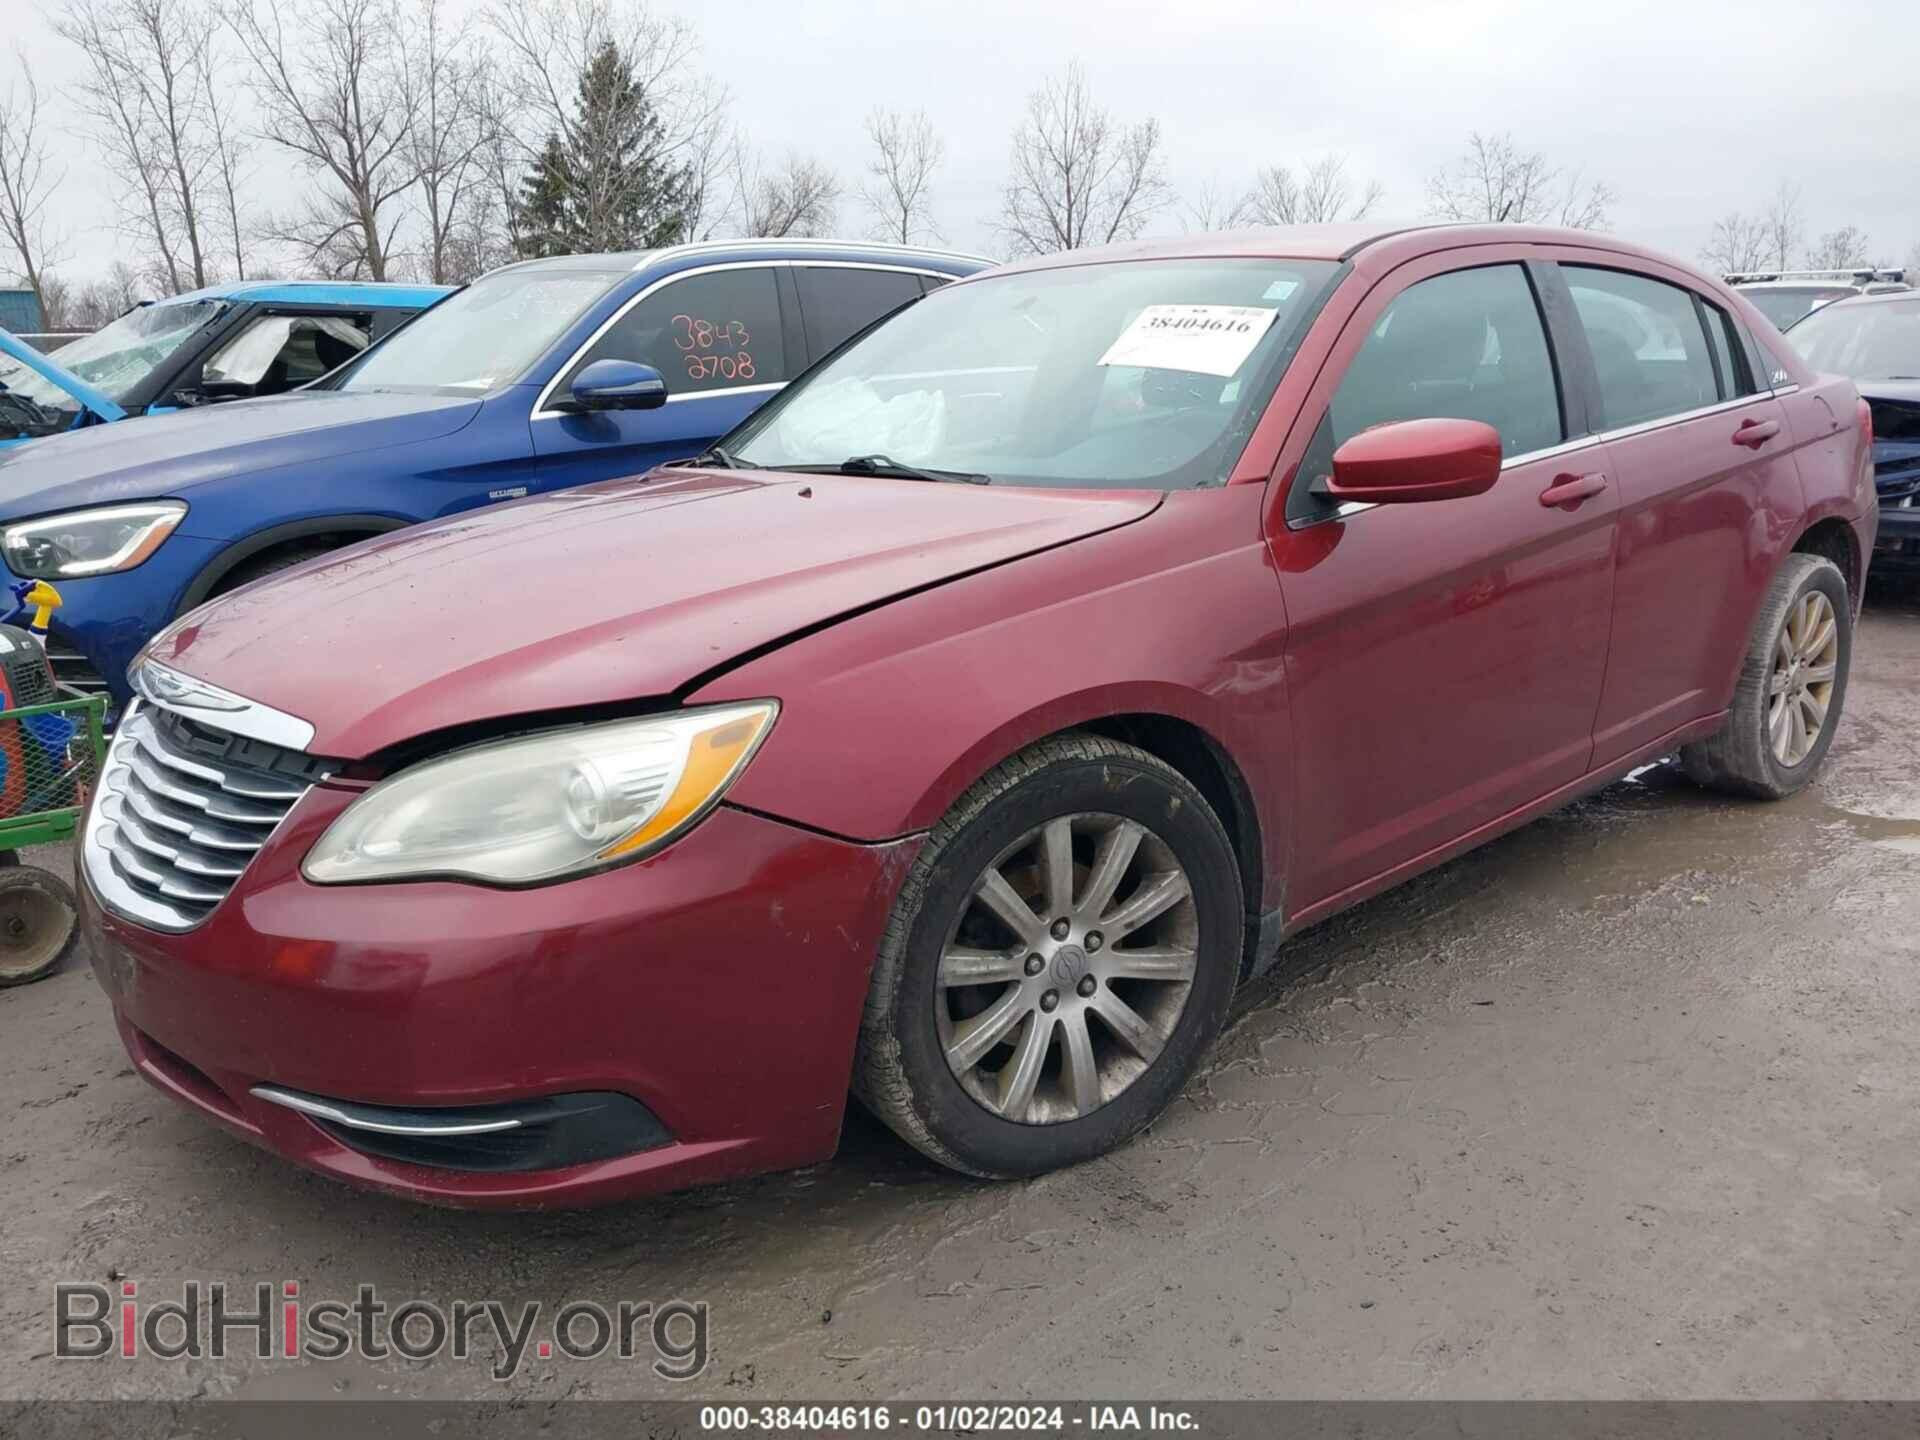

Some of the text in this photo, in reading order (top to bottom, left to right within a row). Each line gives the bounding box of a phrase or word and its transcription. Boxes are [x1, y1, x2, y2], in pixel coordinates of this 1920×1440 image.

[671, 314, 750, 350] 3843
[1148, 317, 1251, 333] 38404616
[684, 351, 756, 379] 2708
